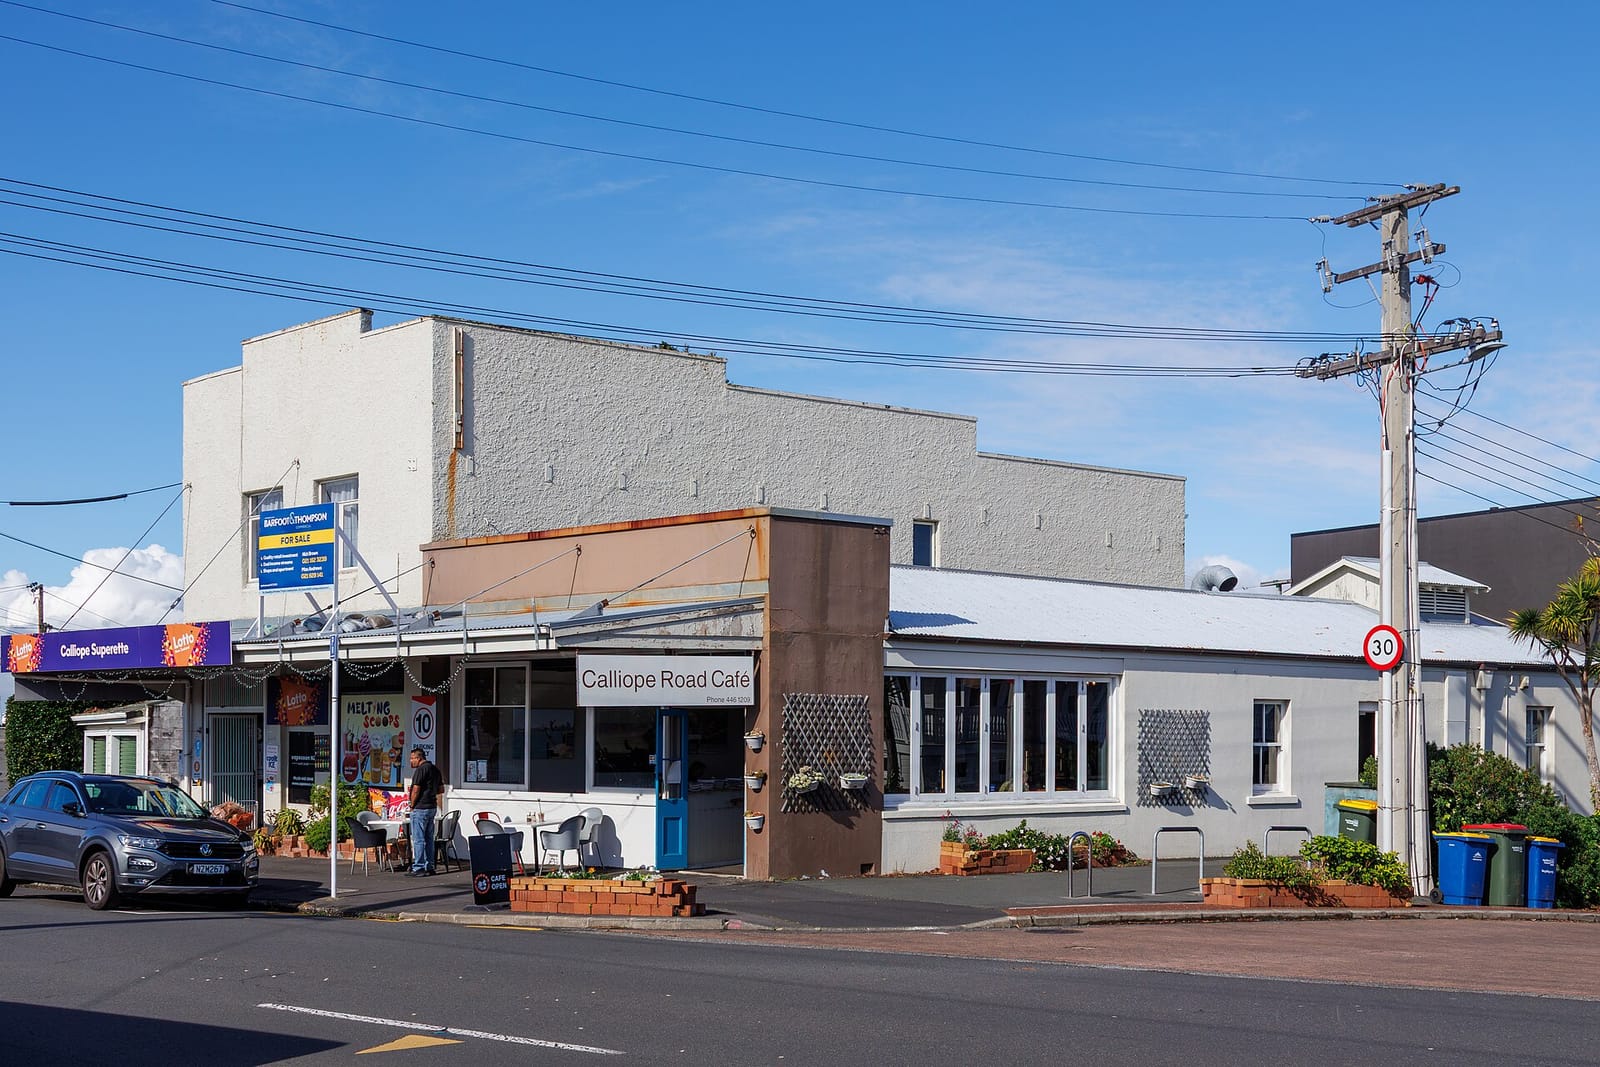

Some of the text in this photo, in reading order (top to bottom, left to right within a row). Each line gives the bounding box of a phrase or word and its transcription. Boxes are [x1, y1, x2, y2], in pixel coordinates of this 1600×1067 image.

[280, 534, 310, 544] FOR SALE
[172, 633, 194, 649] Lotto
[1372, 639, 1394, 656] 30
[16, 642, 32, 656] Lotto
[60, 642, 129, 659] Calliope Superette
[582, 670, 750, 692] Calliope Road Café
[286, 693, 306, 706] Lotto
[347, 701, 390, 715] MELTING
[363, 715, 400, 728] SCOOPS
[416, 714, 431, 733] 10
[196, 865, 223, 873] NZM267
